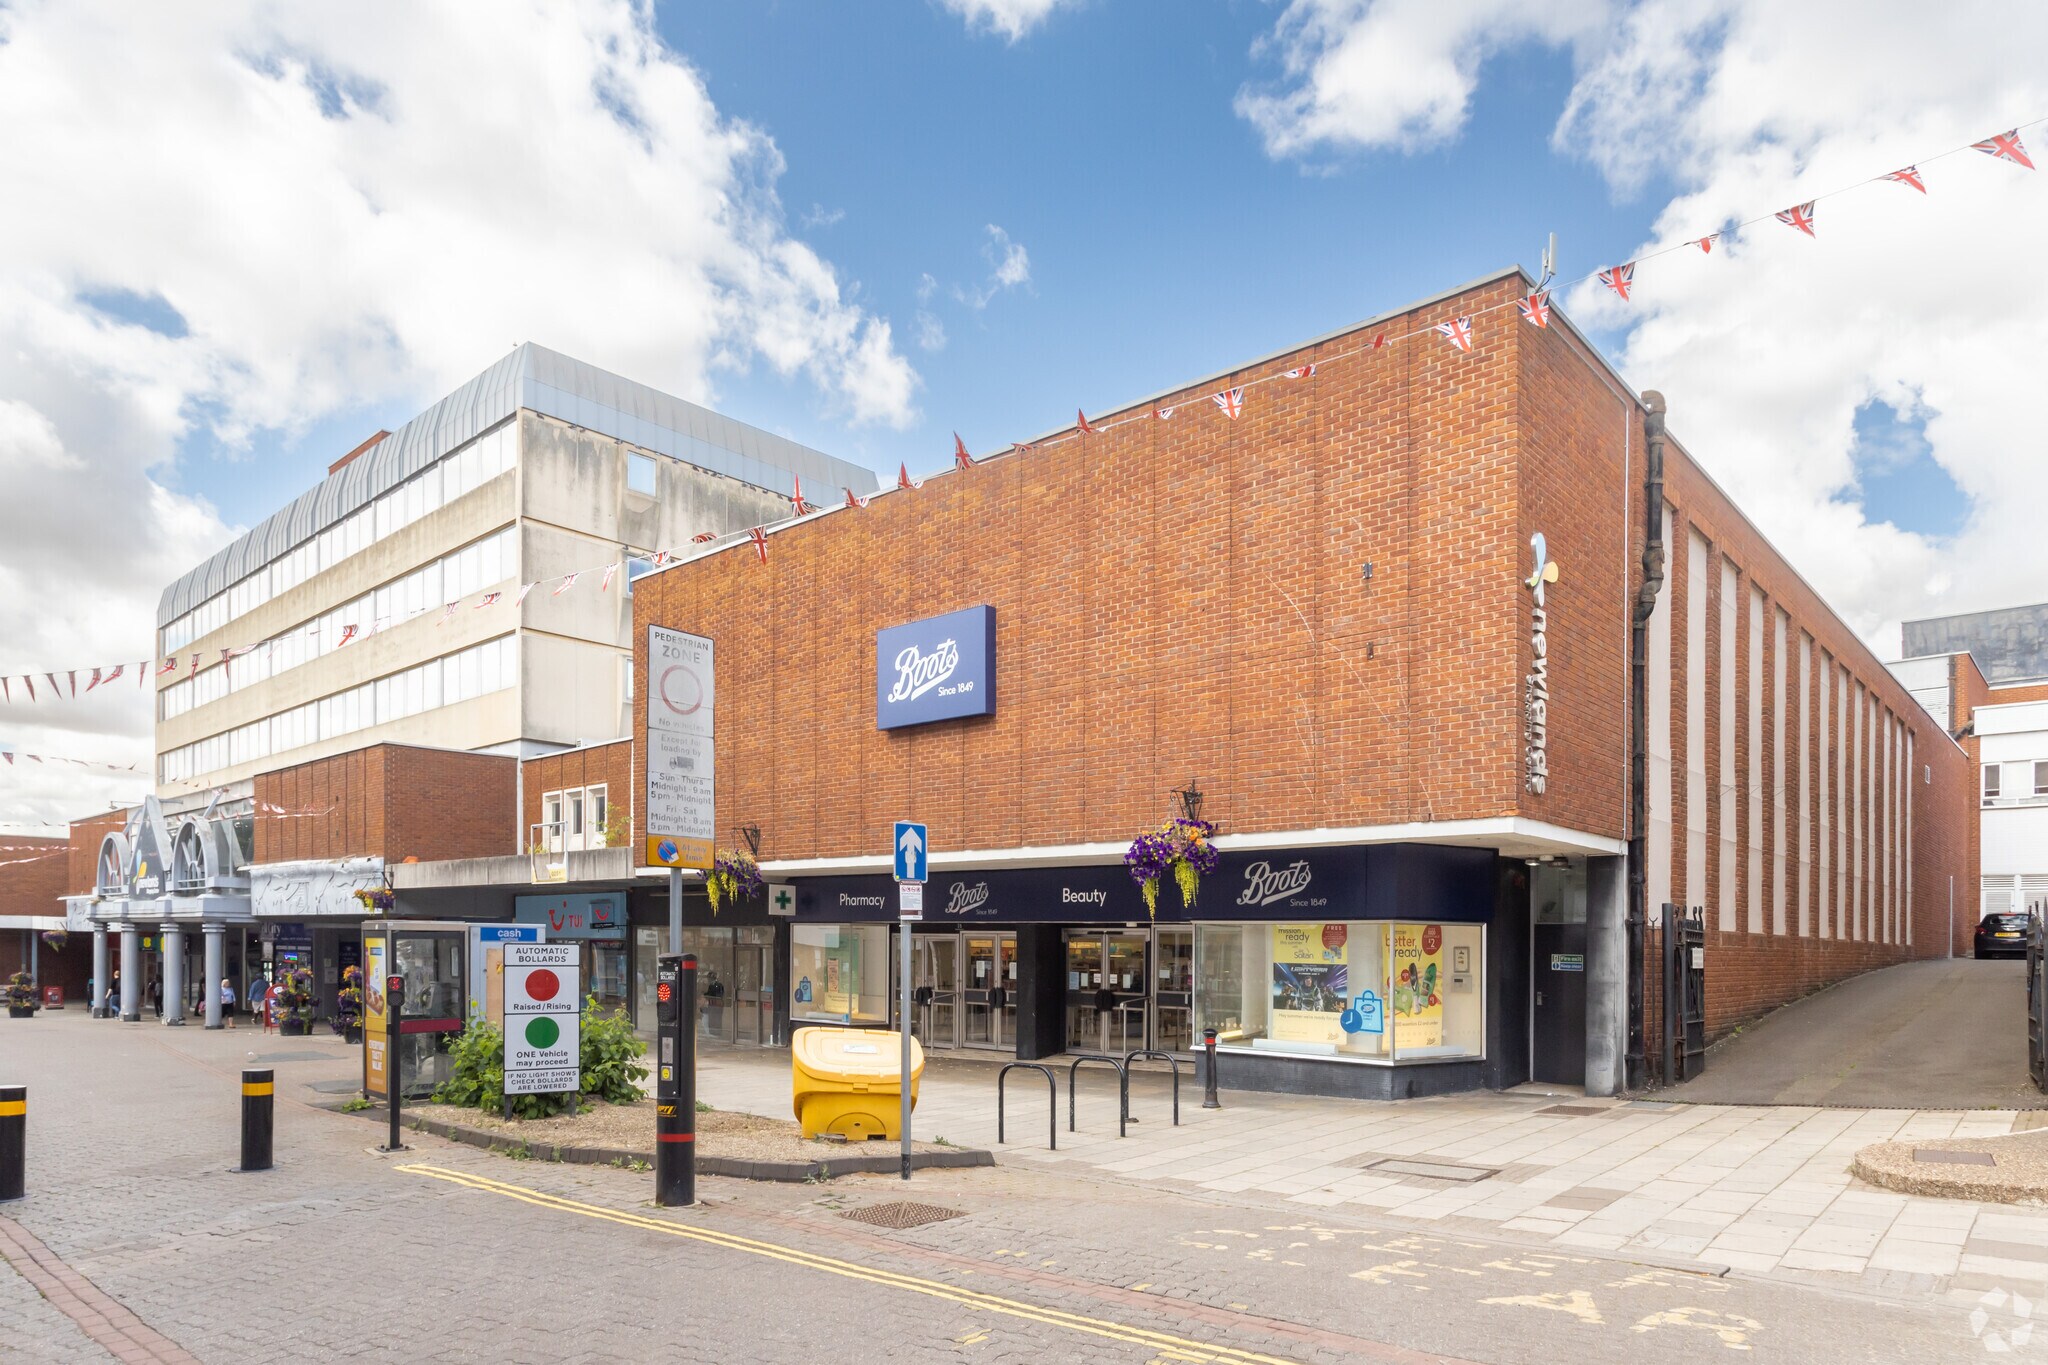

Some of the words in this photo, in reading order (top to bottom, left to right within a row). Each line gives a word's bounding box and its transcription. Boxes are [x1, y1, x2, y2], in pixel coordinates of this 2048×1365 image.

[655, 631, 709, 651] PEDESTRIAN
[662, 645, 701, 663] ZONE
[888, 638, 959, 703] Boots
[938, 687, 956, 697] Since
[957, 681, 974, 694] 1849
[1532, 607, 1549, 795] newlands
[659, 718, 671, 727] No
[661, 734, 686, 746] Except
[661, 744, 690, 756] loading
[692, 748, 701, 757] by
[659, 773, 675, 782] Sun
[682, 775, 703, 785] Thurs
[651, 781, 686, 793] Midnight
[693, 786, 698, 794] 9
[699, 788, 711, 796] am
[651, 790, 656, 798] 5
[657, 793, 671, 801] pm
[676, 793, 712, 805] Midnight
[666, 805, 677, 813] Fri
[683, 806, 697, 815] Sat
[651, 812, 686, 824] Midnight
[700, 818, 711, 826] am
[650, 822, 656, 830] 5
[657, 824, 671, 833] pm
[676, 825, 711, 836] Midnight
[1236, 859, 1312, 907] Boots
[839, 893, 885, 909] Pharmacy
[944, 881, 989, 915] Boots
[1062, 887, 1107, 907] Beauty
[1290, 898, 1309, 907] Since
[1310, 897, 1327, 907] 1849
[568, 914, 583, 928] TUI
[497, 928, 522, 938] cash
[1285, 932, 1310, 943] ready
[1385, 934, 1416, 947] better
[516, 947, 569, 955] AUTOMATIC
[1394, 945, 1423, 961] ready
[518, 955, 567, 963] BOLLARDS
[539, 1050, 568, 1058] Vehicle
[516, 1059, 533, 1067] may
[535, 1058, 569, 1067] proceed
